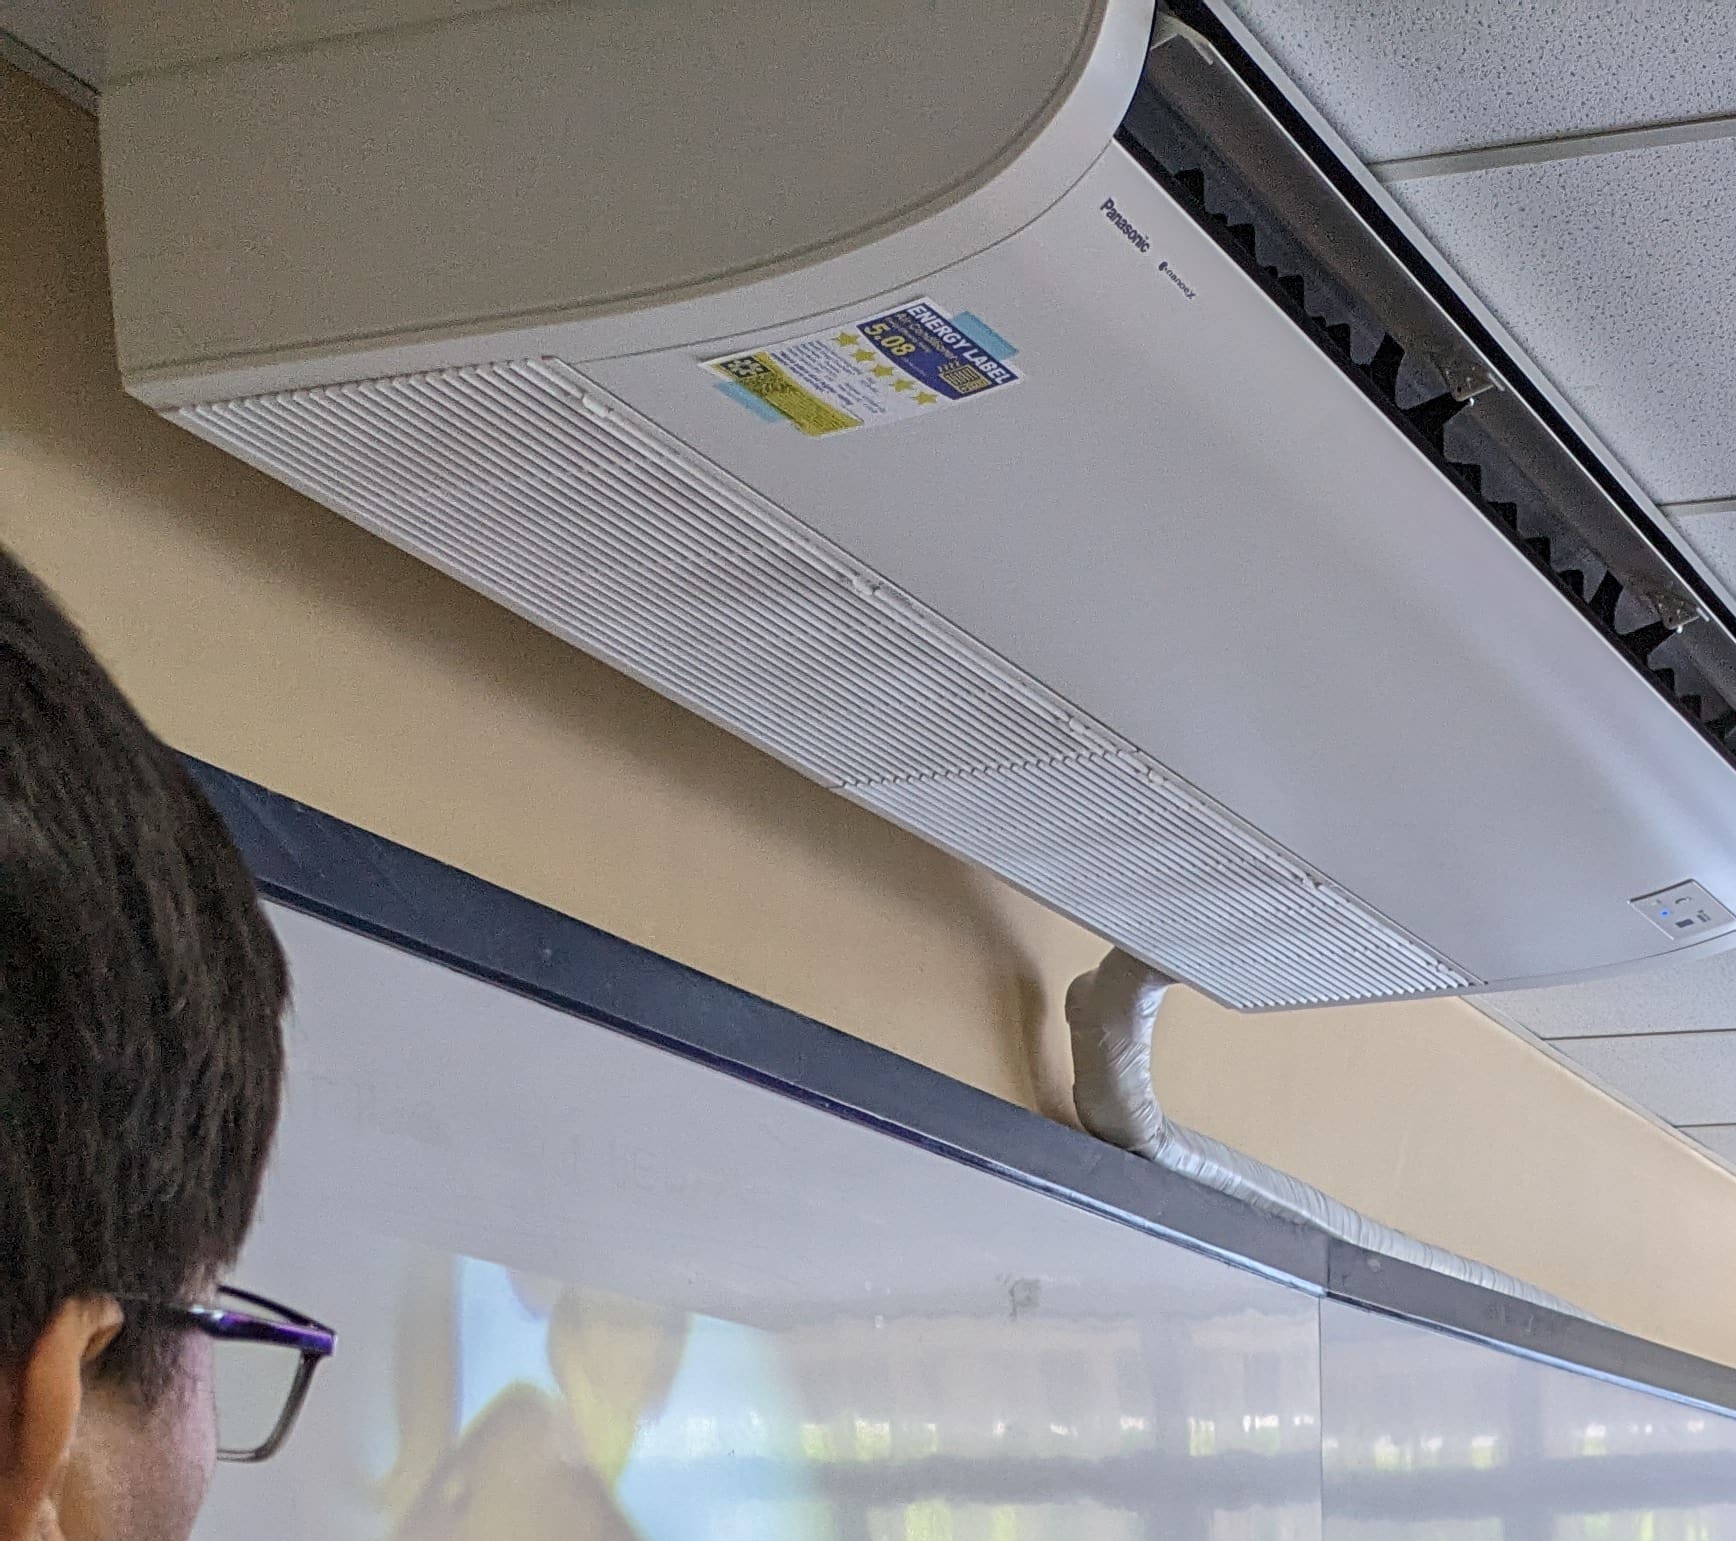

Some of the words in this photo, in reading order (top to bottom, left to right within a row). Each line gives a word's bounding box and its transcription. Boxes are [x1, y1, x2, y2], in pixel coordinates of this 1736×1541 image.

[1100, 198, 1149, 252] Panasonic
[864, 322, 916, 356] 5.08
[907, 304, 973, 350] ENERGY
[963, 349, 1011, 383] LABEL
